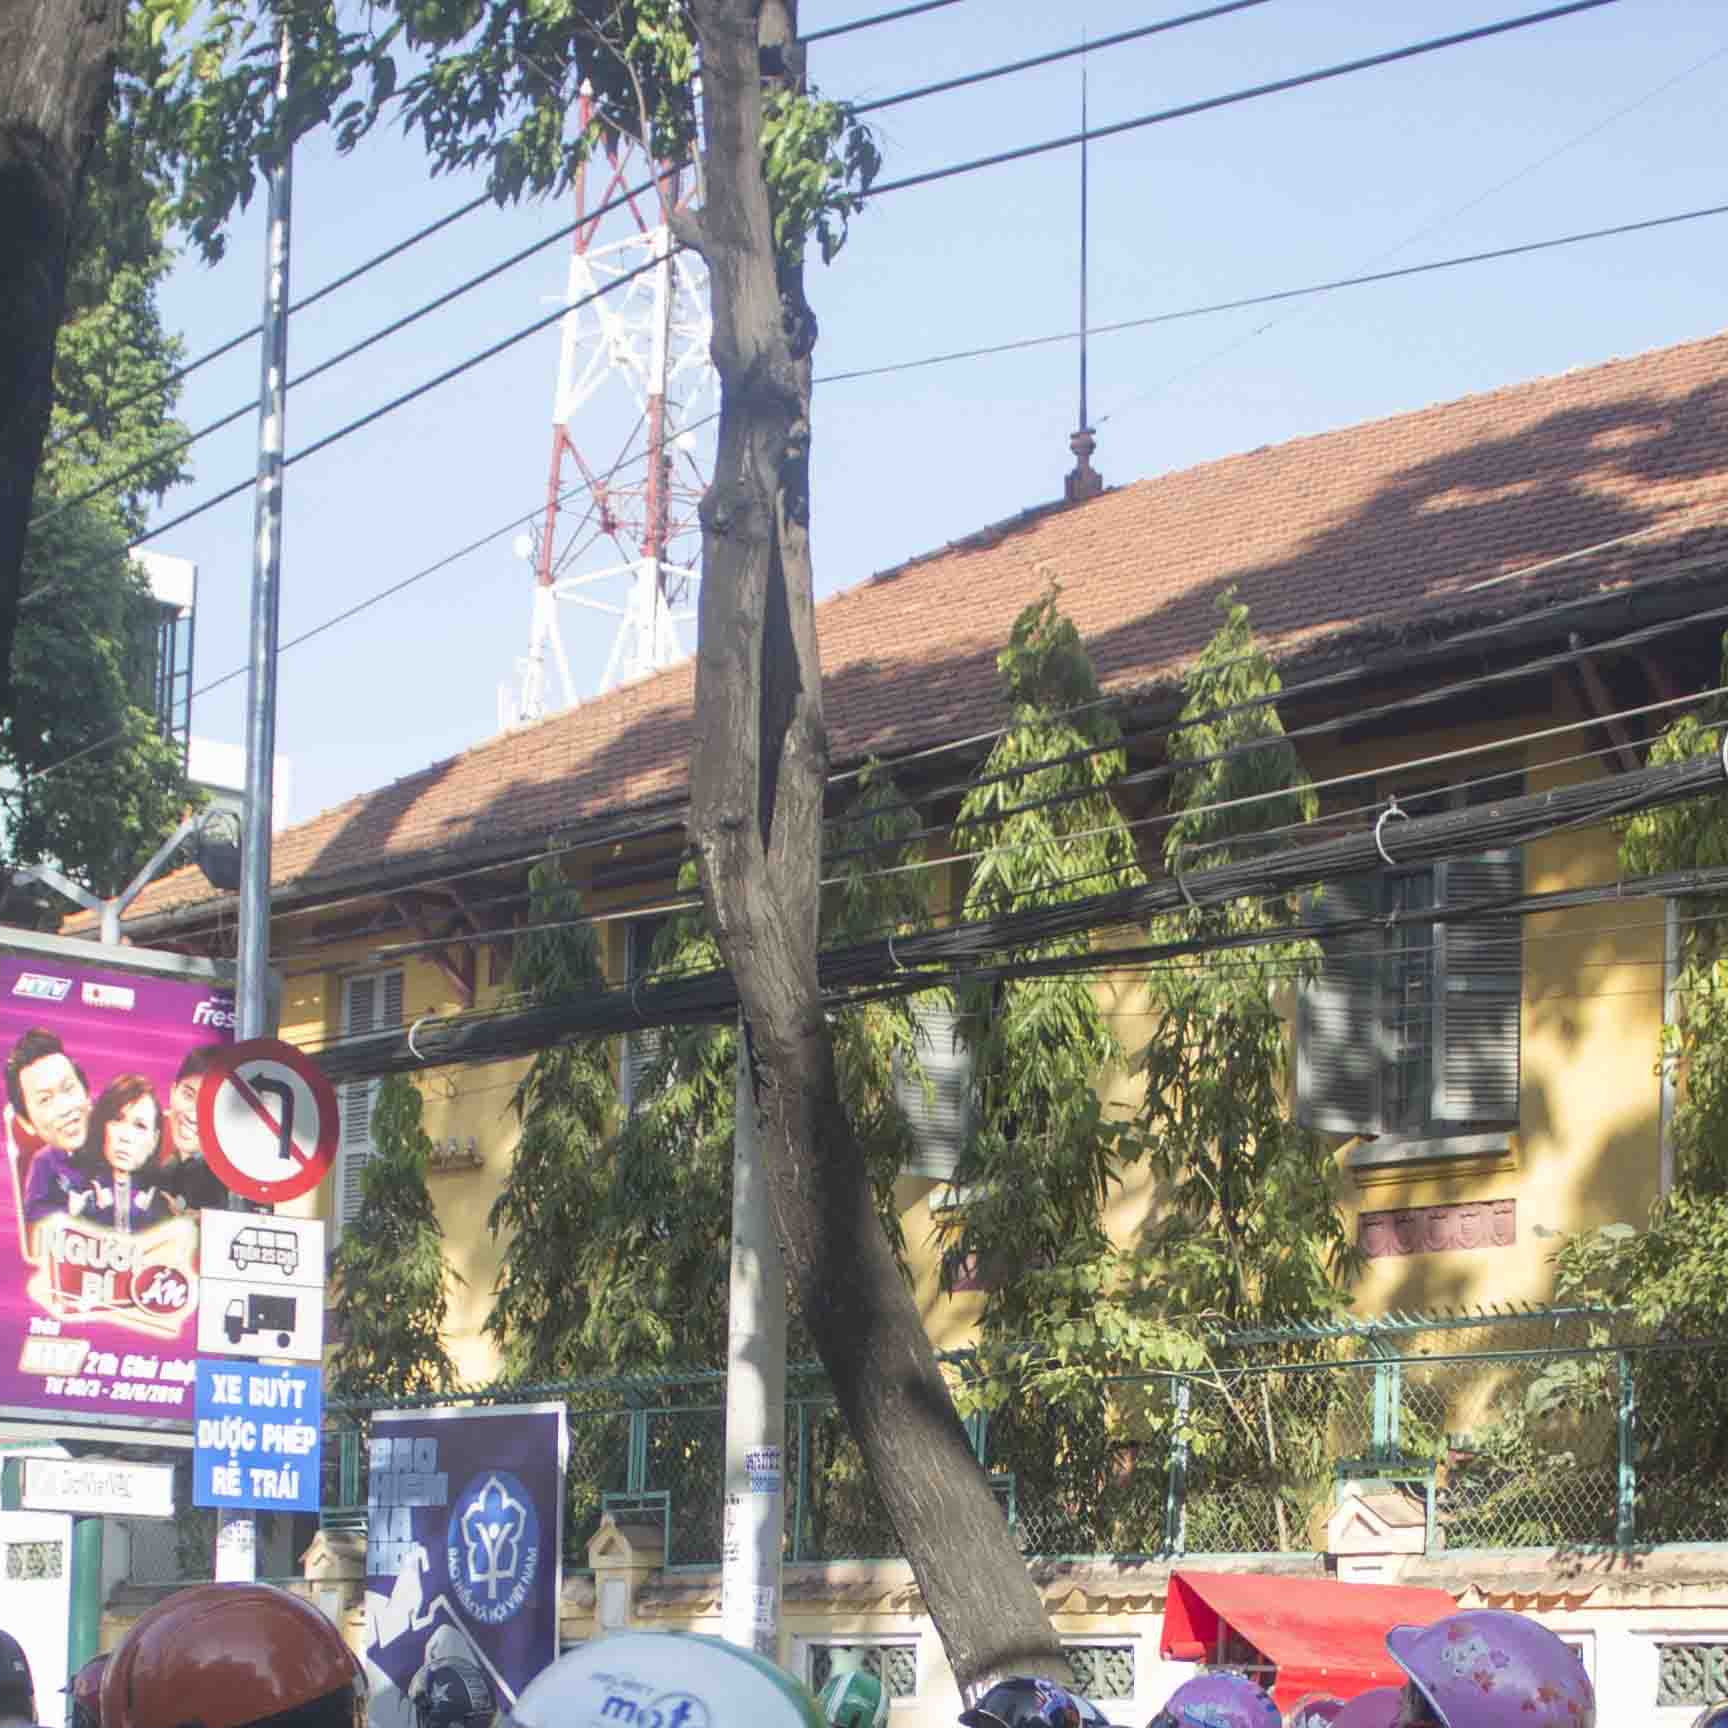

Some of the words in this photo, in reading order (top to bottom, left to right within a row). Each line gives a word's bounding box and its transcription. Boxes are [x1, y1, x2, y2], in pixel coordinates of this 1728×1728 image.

[210, 1373, 242, 1405] XE
[248, 1370, 307, 1409] BUÝT
[198, 1415, 257, 1458] ĐƯỢC
[261, 1417, 317, 1457] PHÉP
[248, 1461, 300, 1500] TRÁI
